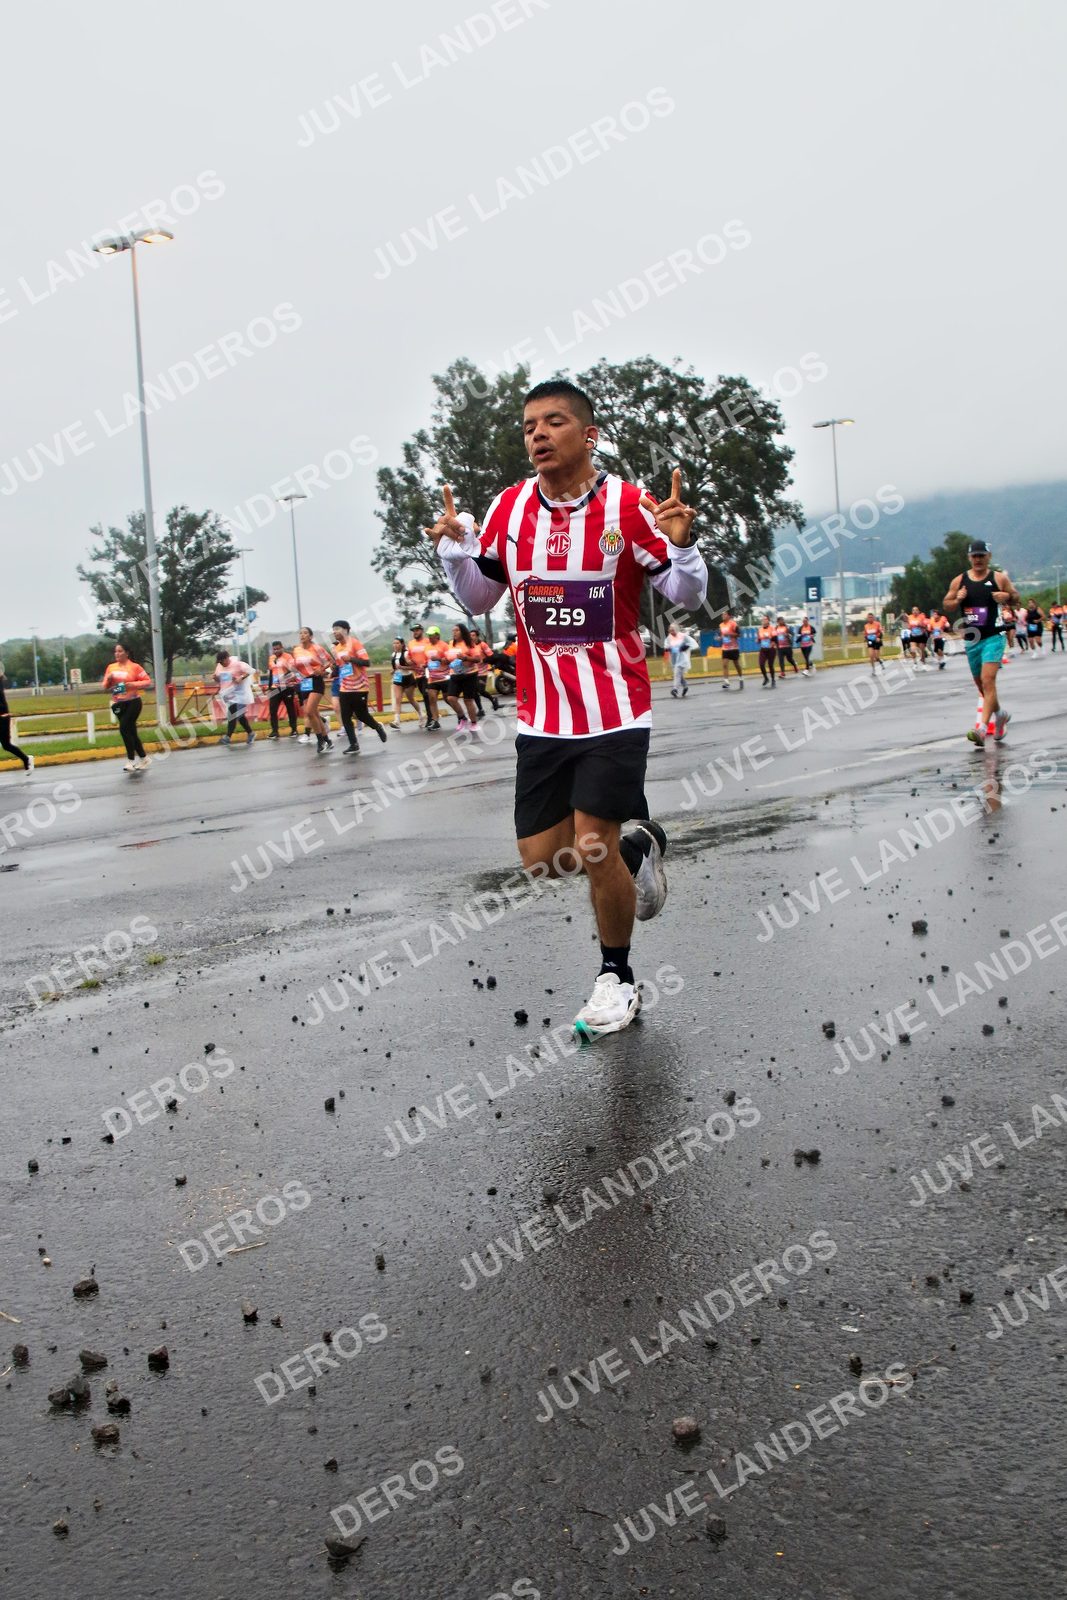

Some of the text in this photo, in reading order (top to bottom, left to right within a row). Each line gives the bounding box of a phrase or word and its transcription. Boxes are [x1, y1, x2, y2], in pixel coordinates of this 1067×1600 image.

[548, 534, 570, 554] MG
[528, 585, 564, 596] CARRERA
[808, 587, 818, 599] E
[545, 607, 586, 626] 259
[557, 646, 579, 655] pago
